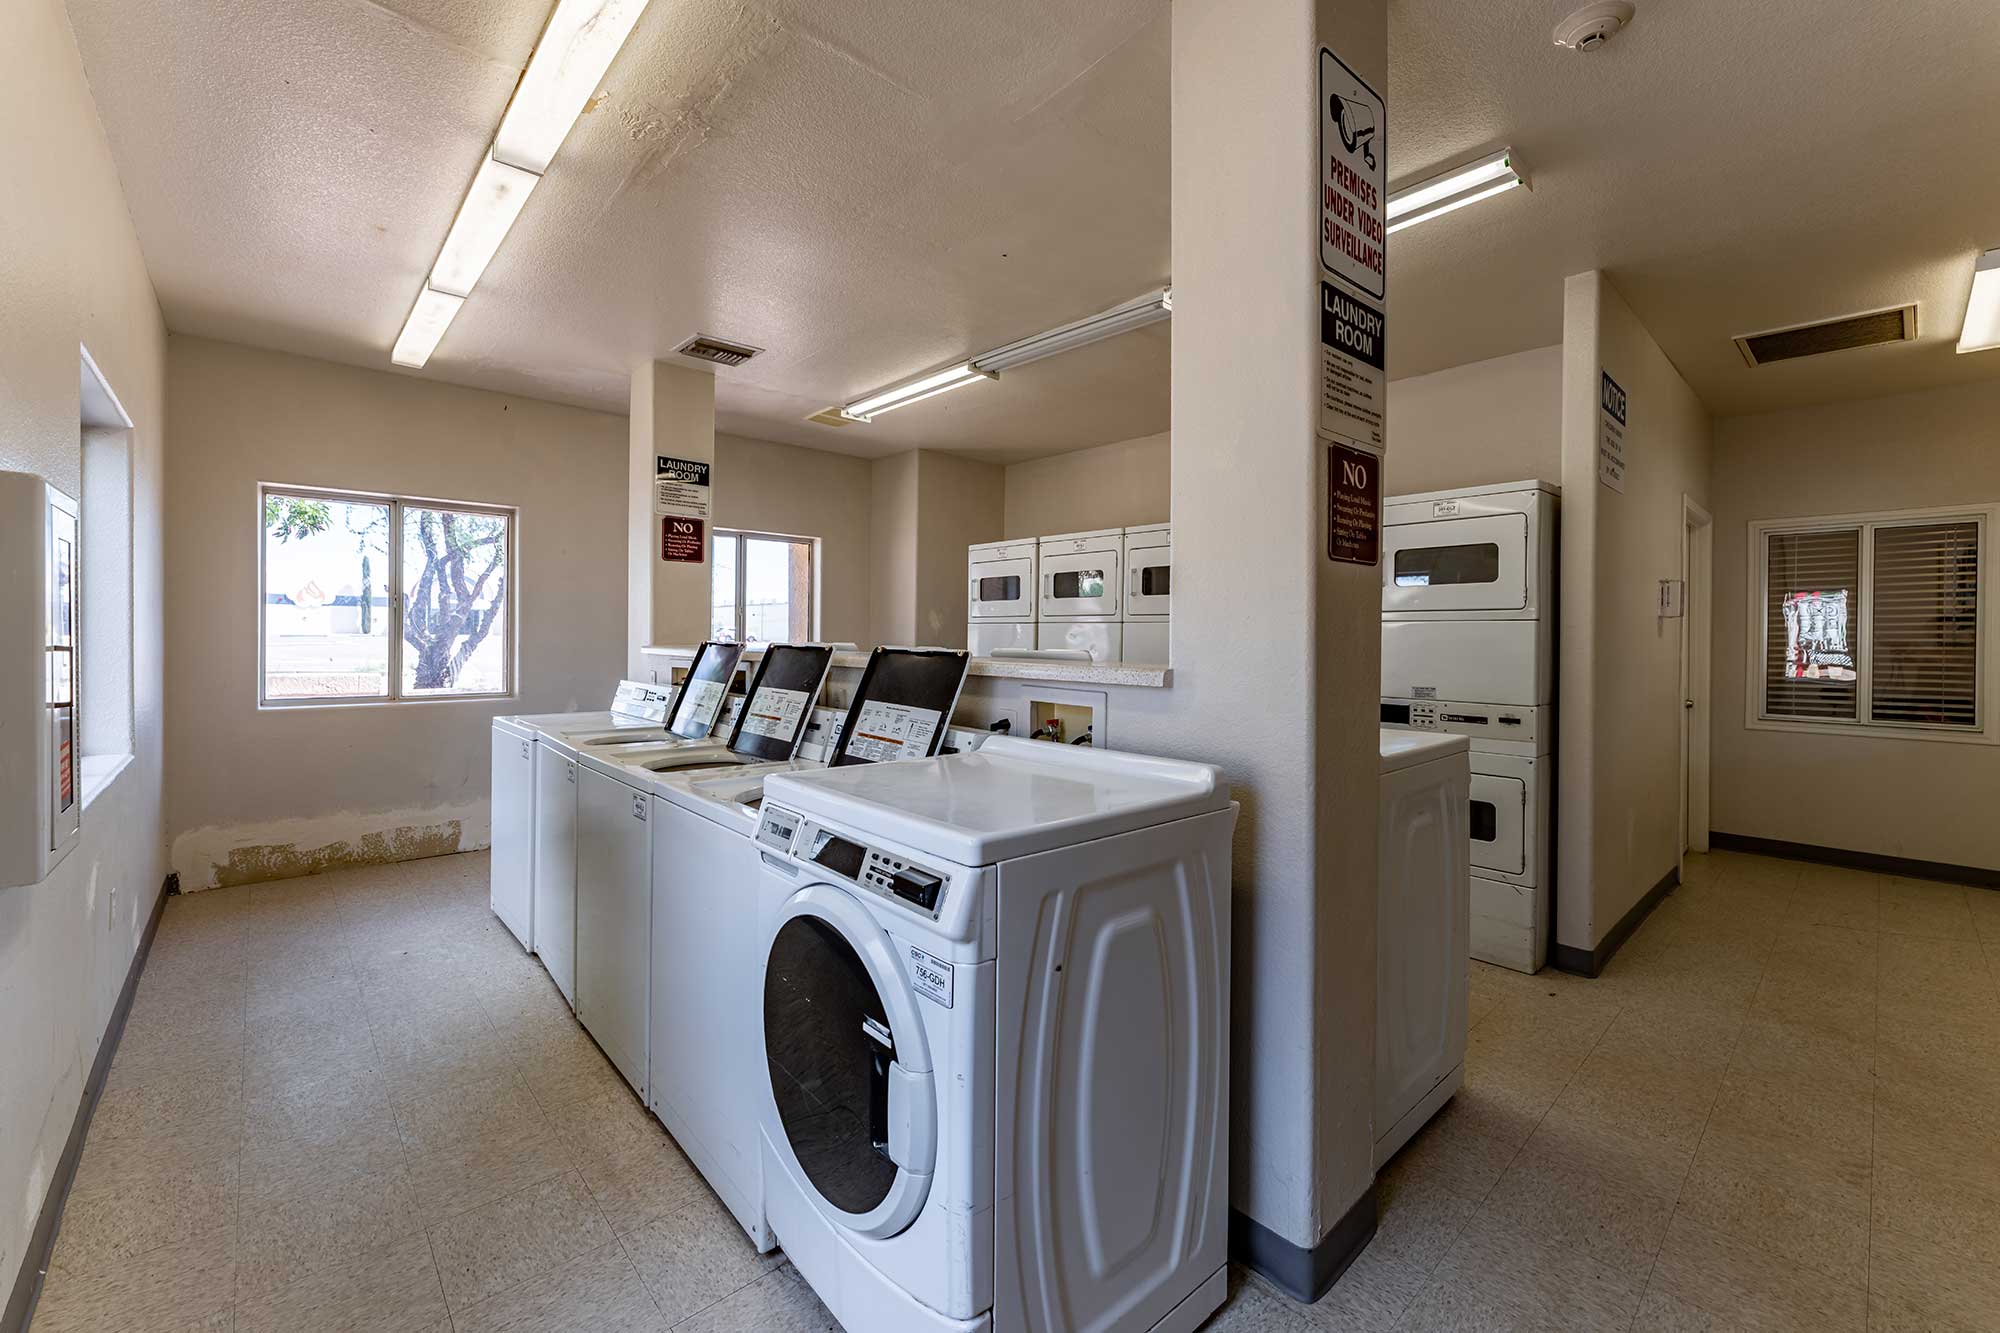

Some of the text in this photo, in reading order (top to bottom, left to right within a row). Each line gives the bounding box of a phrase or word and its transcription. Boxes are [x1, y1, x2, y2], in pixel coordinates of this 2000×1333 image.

[1331, 154, 1377, 211] PREMISES
[1324, 183, 1382, 245] UNDER VIDEO
[1324, 216, 1383, 275] SURVEILLANCE
[1324, 289, 1382, 337] LAUNDRY
[1335, 320, 1373, 356] ROOM
[1603, 377, 1625, 421] NOTICE
[660, 459, 707, 474] LAUNDRY
[669, 469, 699, 482] ROOM
[1343, 460, 1367, 489] NO
[673, 522, 693, 534] NO
